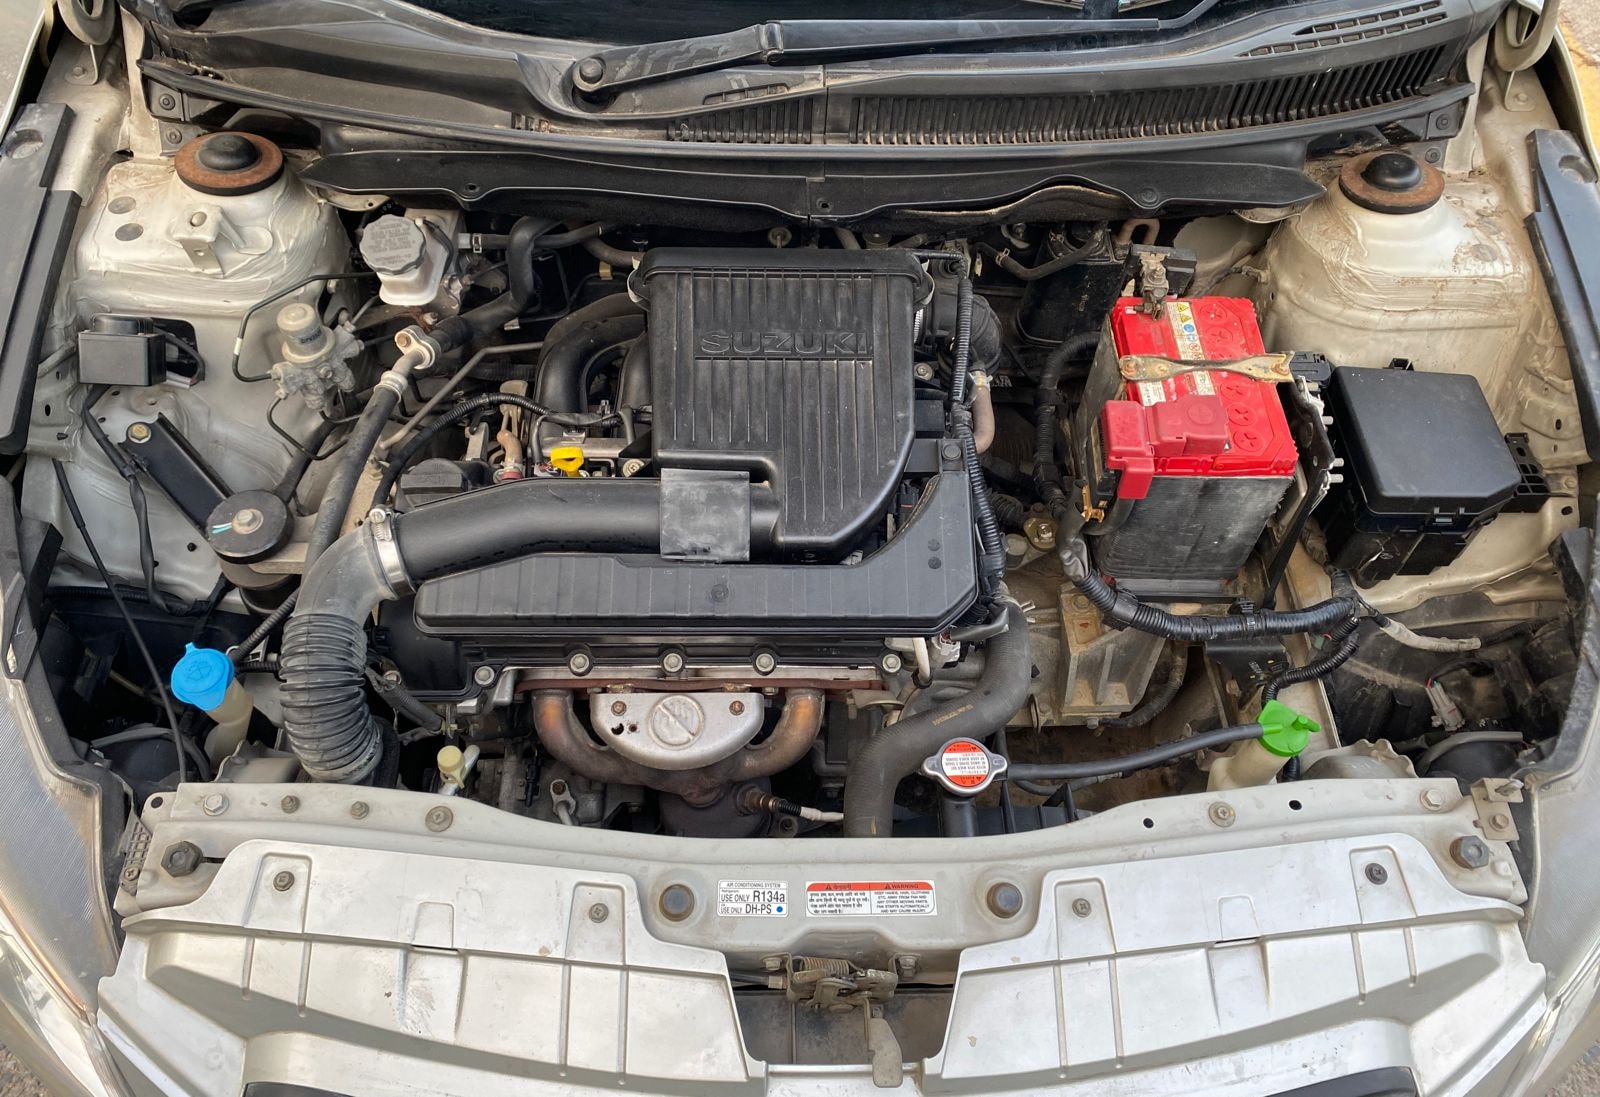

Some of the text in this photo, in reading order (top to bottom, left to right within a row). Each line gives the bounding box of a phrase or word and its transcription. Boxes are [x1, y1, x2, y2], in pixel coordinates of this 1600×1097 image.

[701, 331, 868, 355] SUZUKI
[753, 890, 785, 902] R134a
[746, 904, 772, 914] DH-PS
